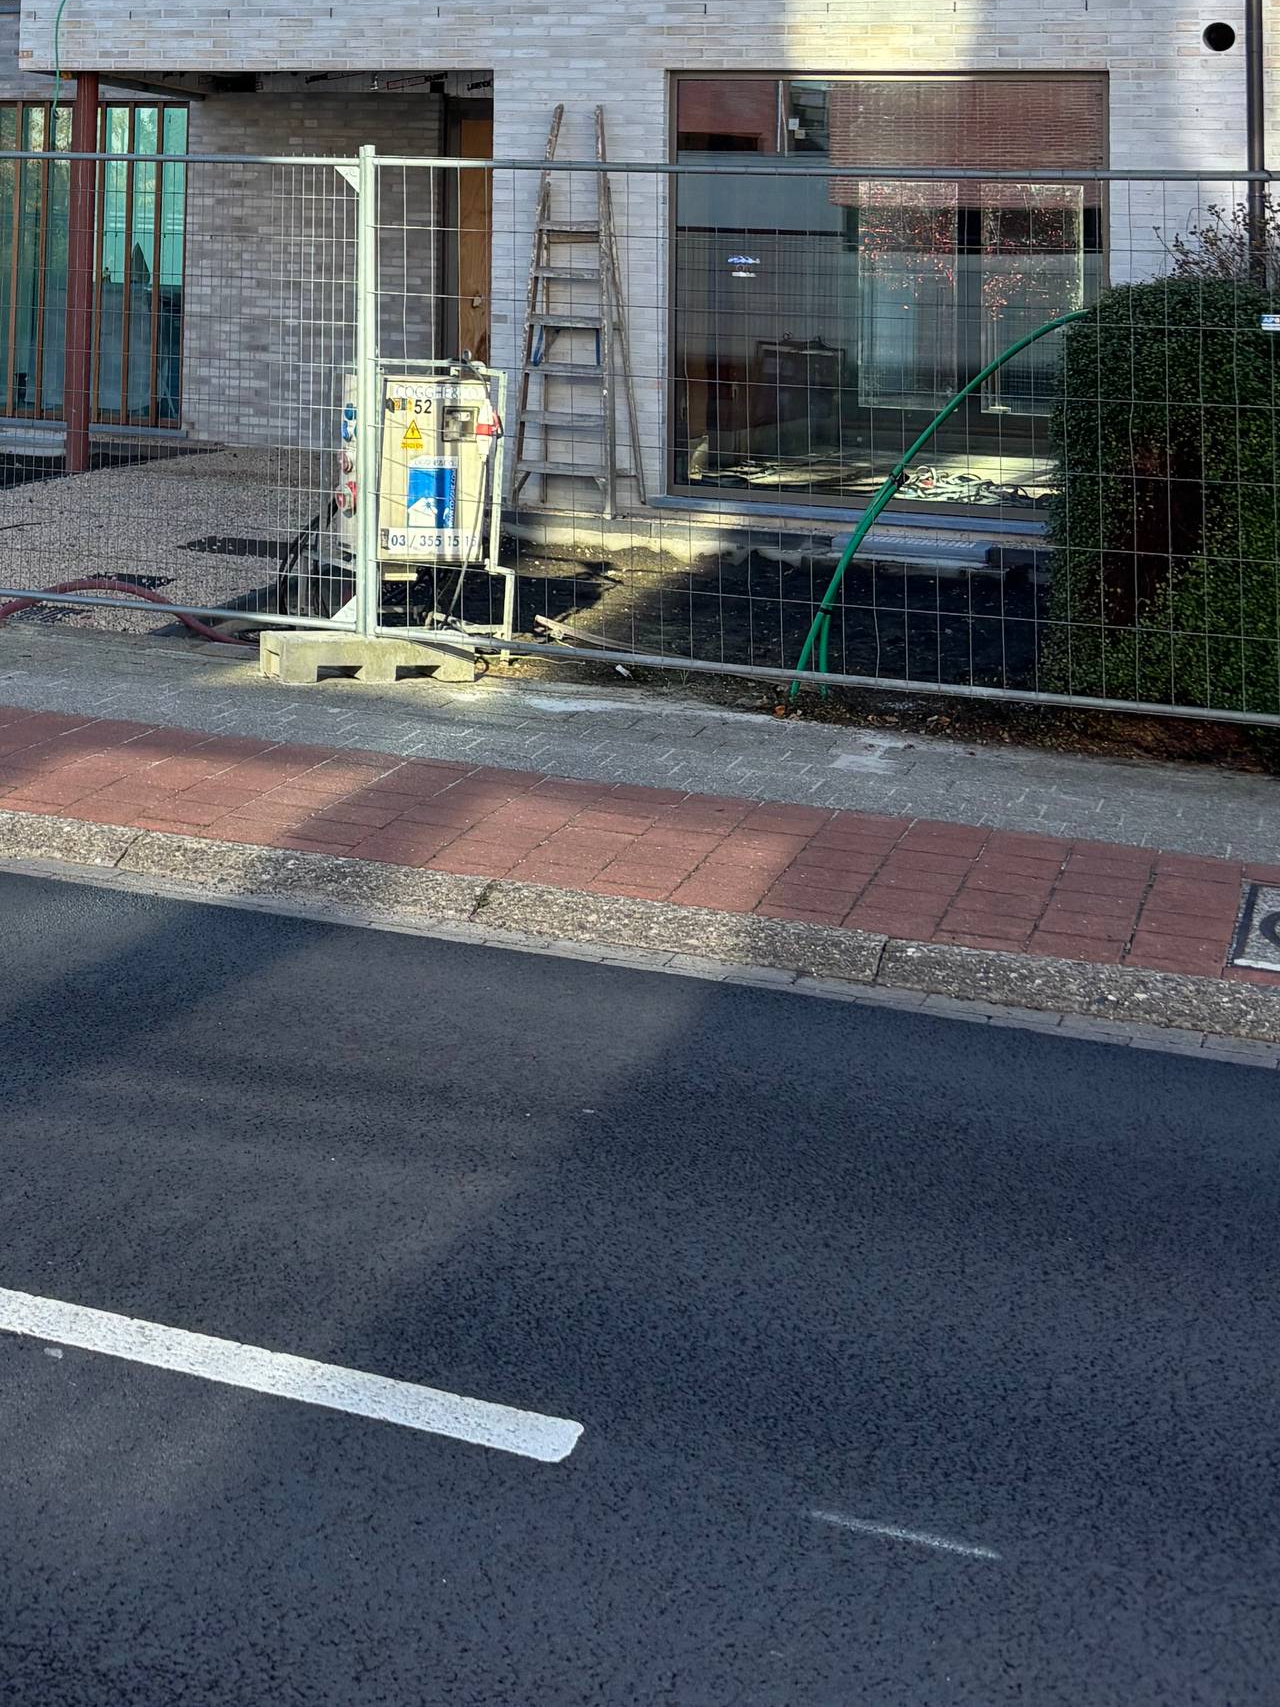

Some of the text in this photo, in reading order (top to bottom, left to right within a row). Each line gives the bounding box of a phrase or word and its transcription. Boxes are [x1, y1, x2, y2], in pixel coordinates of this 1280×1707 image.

[414, 399, 432, 414] 52
[391, 535, 406, 546] 03
[420, 536, 442, 546] 355
[448, 536, 460, 546] 15
